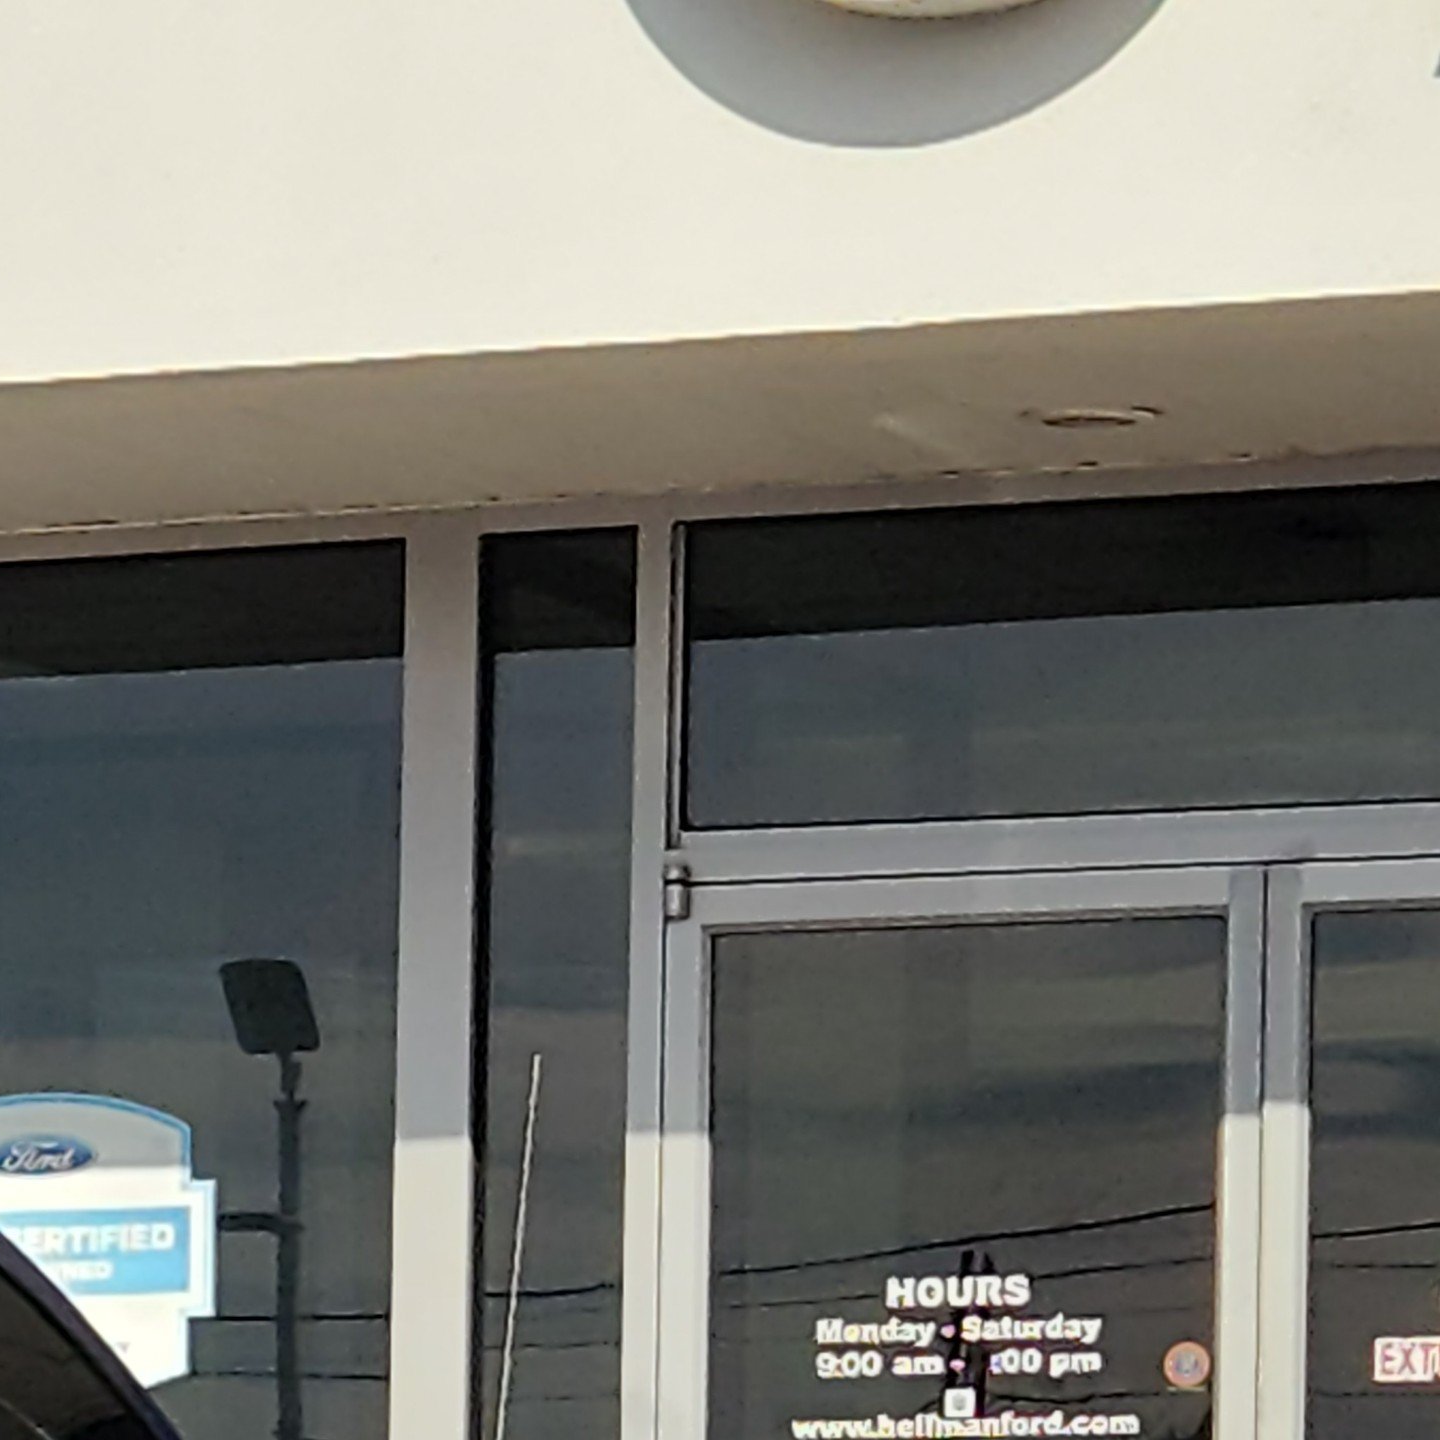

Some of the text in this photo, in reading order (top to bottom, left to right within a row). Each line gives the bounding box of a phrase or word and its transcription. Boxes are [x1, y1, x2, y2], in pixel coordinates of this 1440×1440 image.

[1, 1140, 76, 1172] Ford
[885, 1273, 1032, 1308] HOURS
[815, 1316, 936, 1347] Monday
[960, 1312, 1103, 1344] Saturday
[892, 1352, 945, 1376] am
[1049, 1351, 1102, 1379] pm
